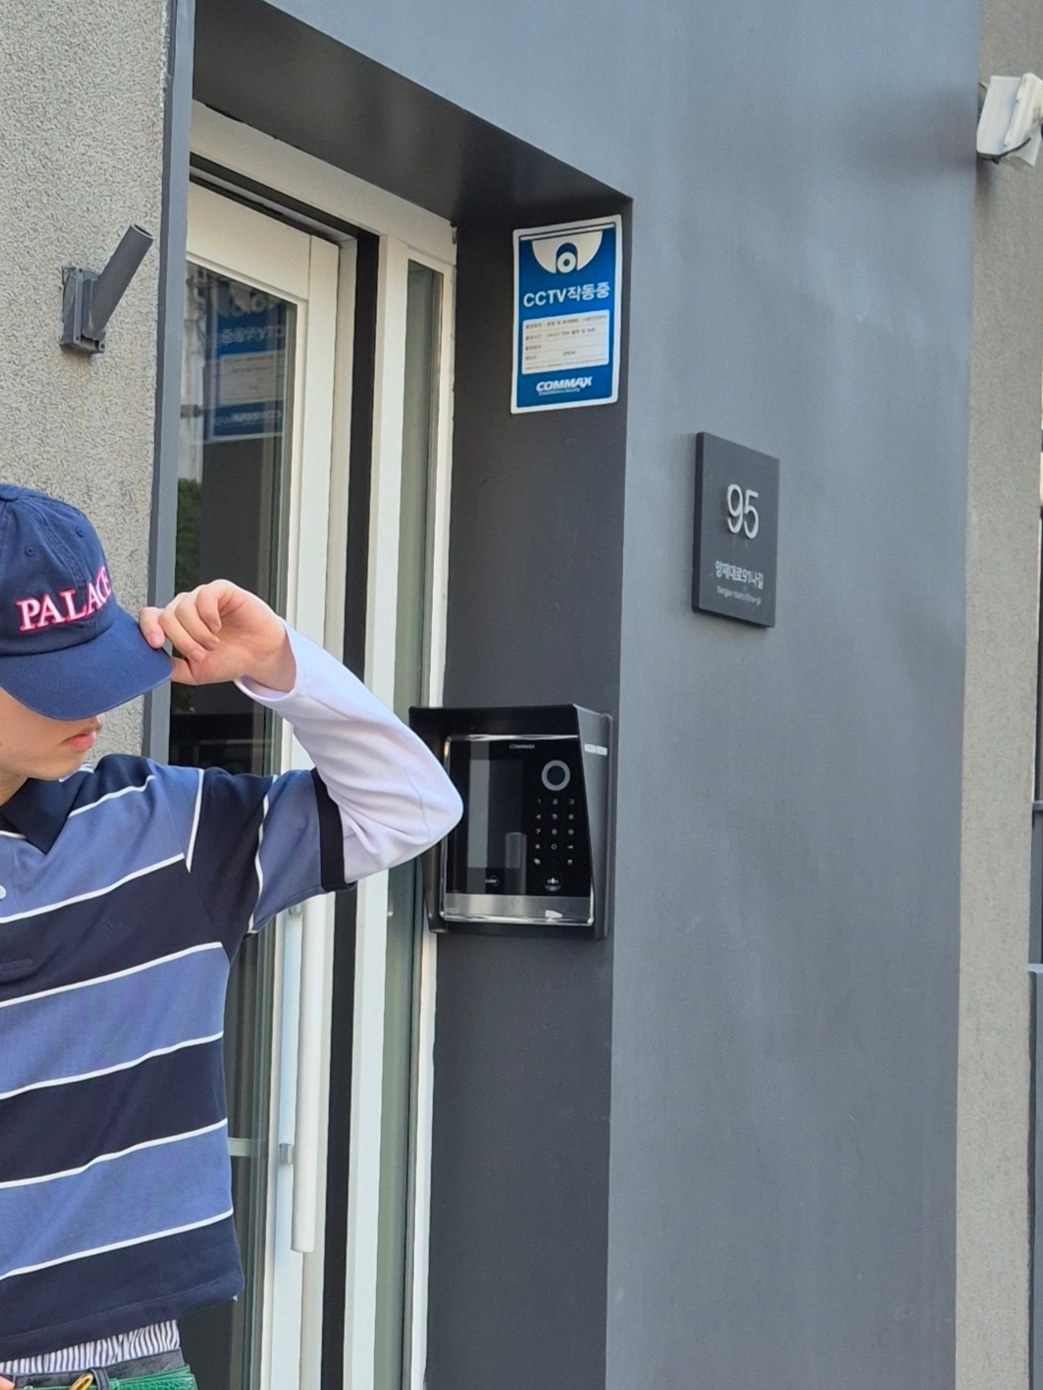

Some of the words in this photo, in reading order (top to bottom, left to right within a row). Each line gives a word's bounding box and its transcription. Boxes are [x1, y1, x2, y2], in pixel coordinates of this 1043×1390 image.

[523, 282, 610, 307] CCTV작동중
[536, 376, 593, 392] COMMAX
[727, 483, 759, 539] 95
